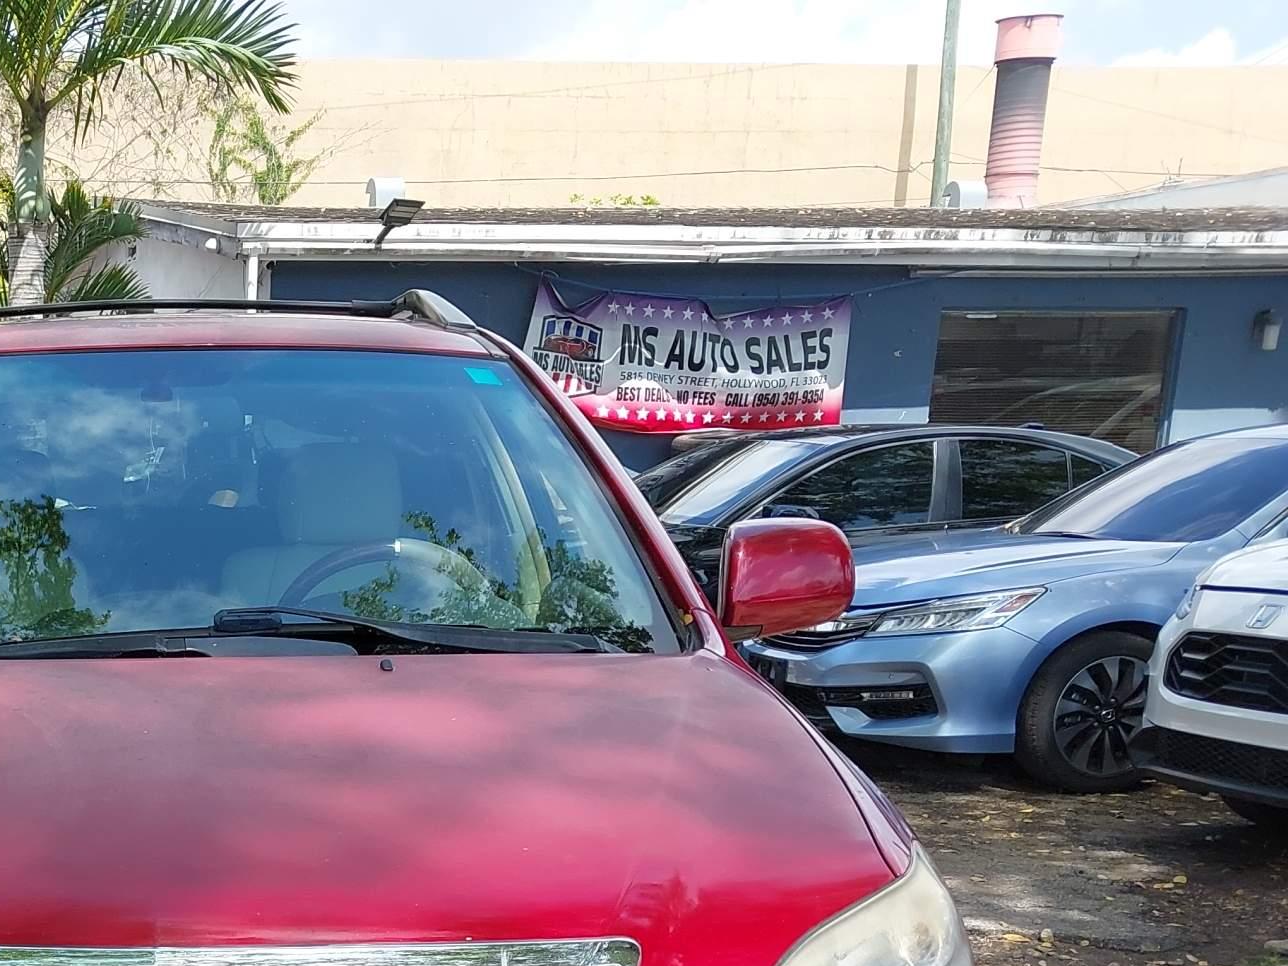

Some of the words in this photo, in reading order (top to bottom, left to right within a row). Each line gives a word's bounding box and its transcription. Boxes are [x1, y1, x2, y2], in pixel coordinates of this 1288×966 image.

[619, 324, 658, 367] MS
[664, 329, 739, 373] AUTO
[745, 328, 833, 374] SALES
[533, 352, 549, 371] MS
[620, 372, 643, 381] 5815
[677, 375, 717, 388] STREET,
[722, 378, 787, 389] HOLLYWOOD,
[791, 377, 800, 386] FL
[616, 387, 641, 401] BEST
[677, 390, 689, 404] NO
[692, 392, 716, 406] FEES
[725, 393, 750, 407] CALL
[752, 392, 780, 408] (954)
[781, 389, 824, 405] 391-9354
